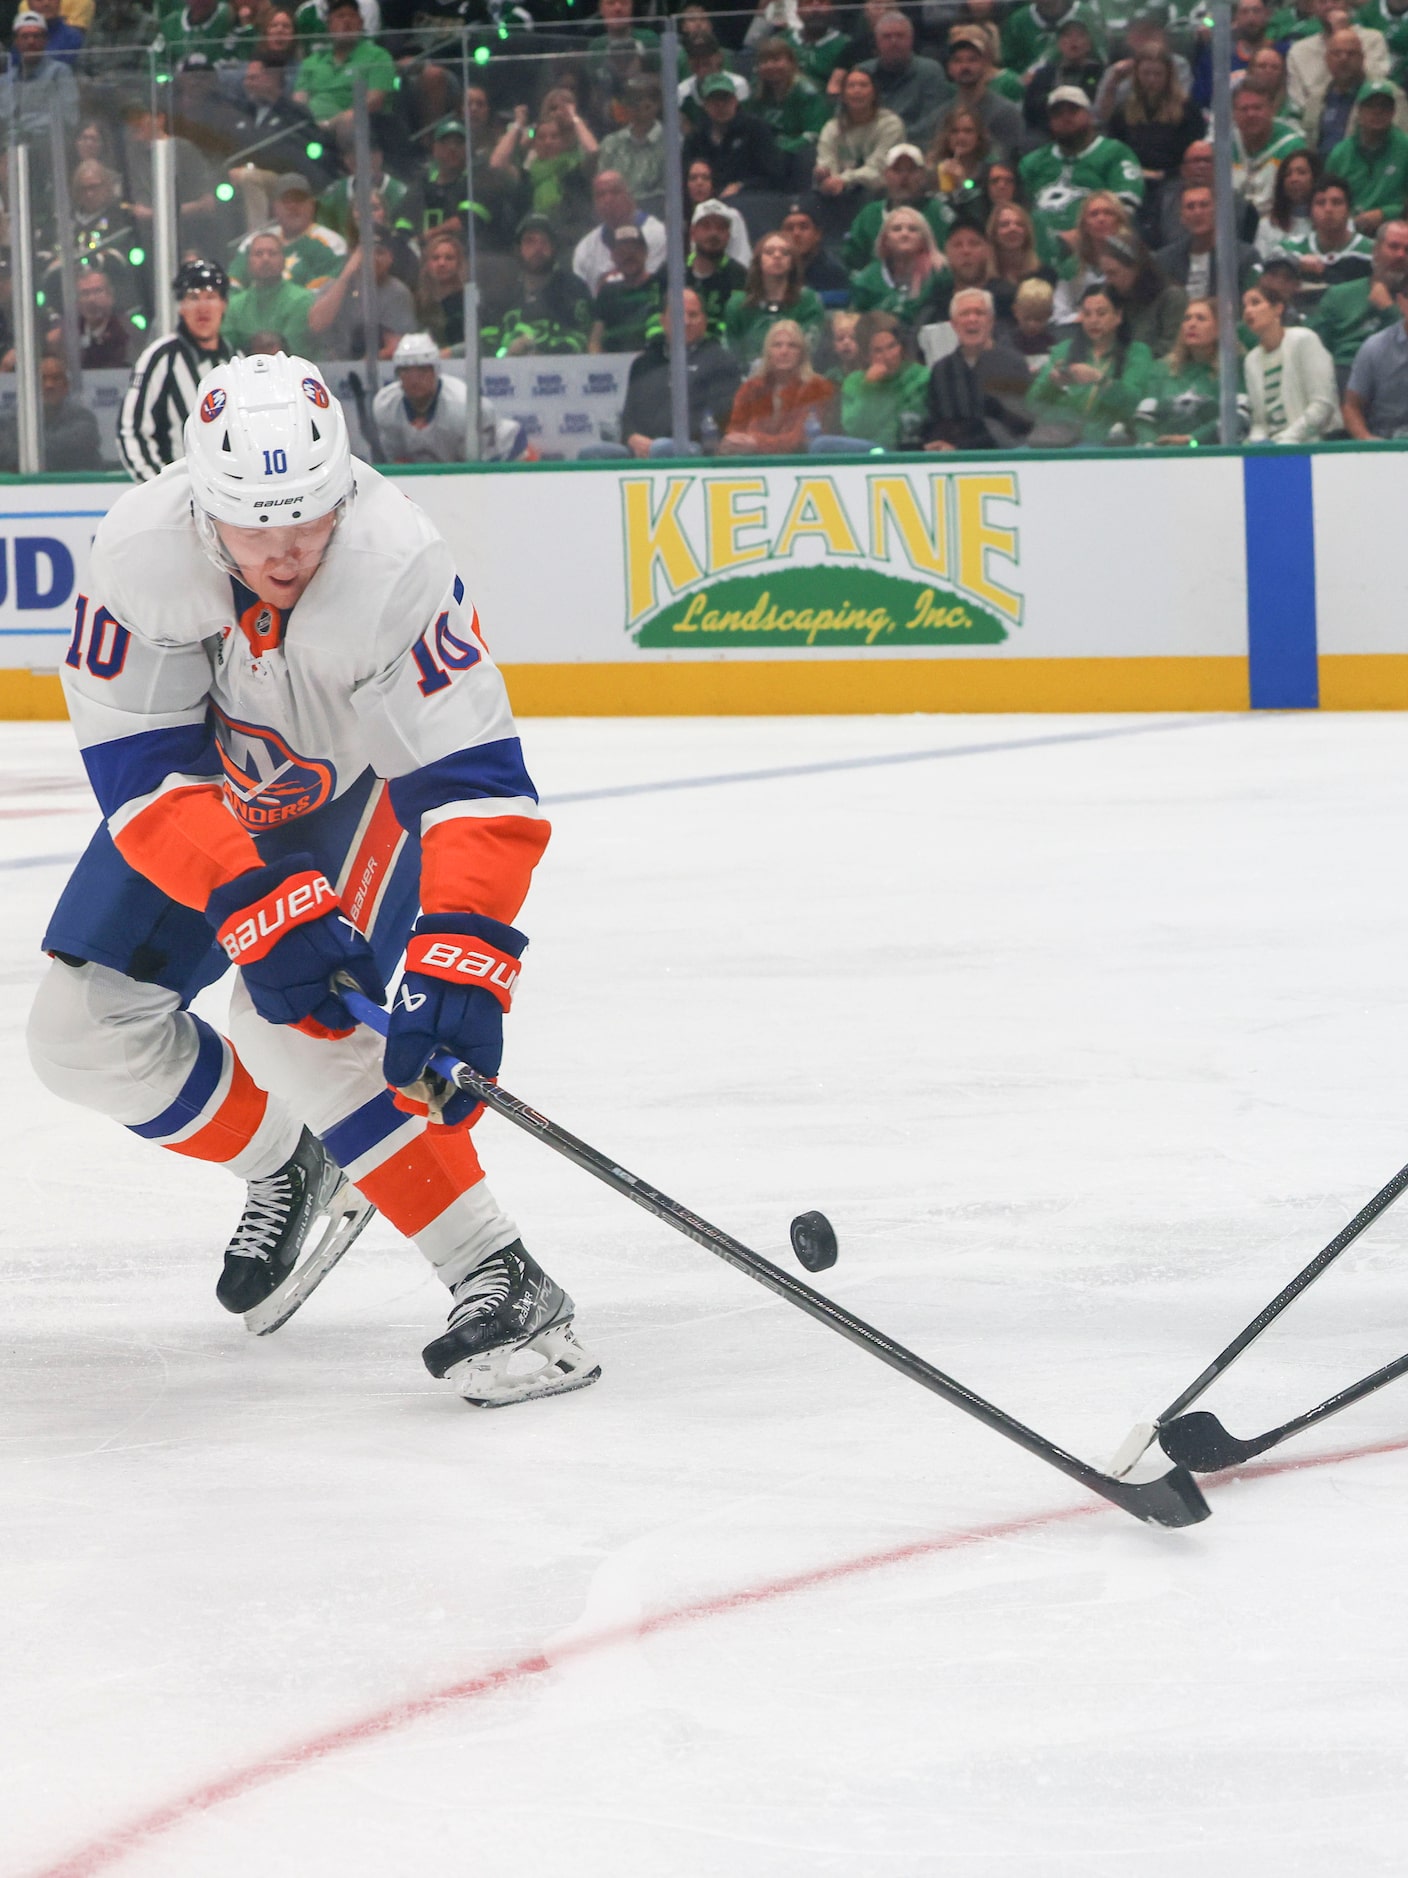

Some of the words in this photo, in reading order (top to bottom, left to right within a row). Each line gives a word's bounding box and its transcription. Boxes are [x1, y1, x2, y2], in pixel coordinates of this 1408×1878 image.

[263, 449, 288, 476] 10
[253, 496, 304, 509] BAUER
[619, 471, 1025, 633] KEANE
[65, 593, 131, 681] 10
[672, 591, 896, 645] Landscaping,
[906, 589, 973, 630] Inc.
[411, 611, 482, 698] 10
[223, 780, 311, 824] ANDERS
[221, 876, 336, 960] BAUER
[350, 855, 379, 922] BAUER
[420, 942, 519, 995] BAU
